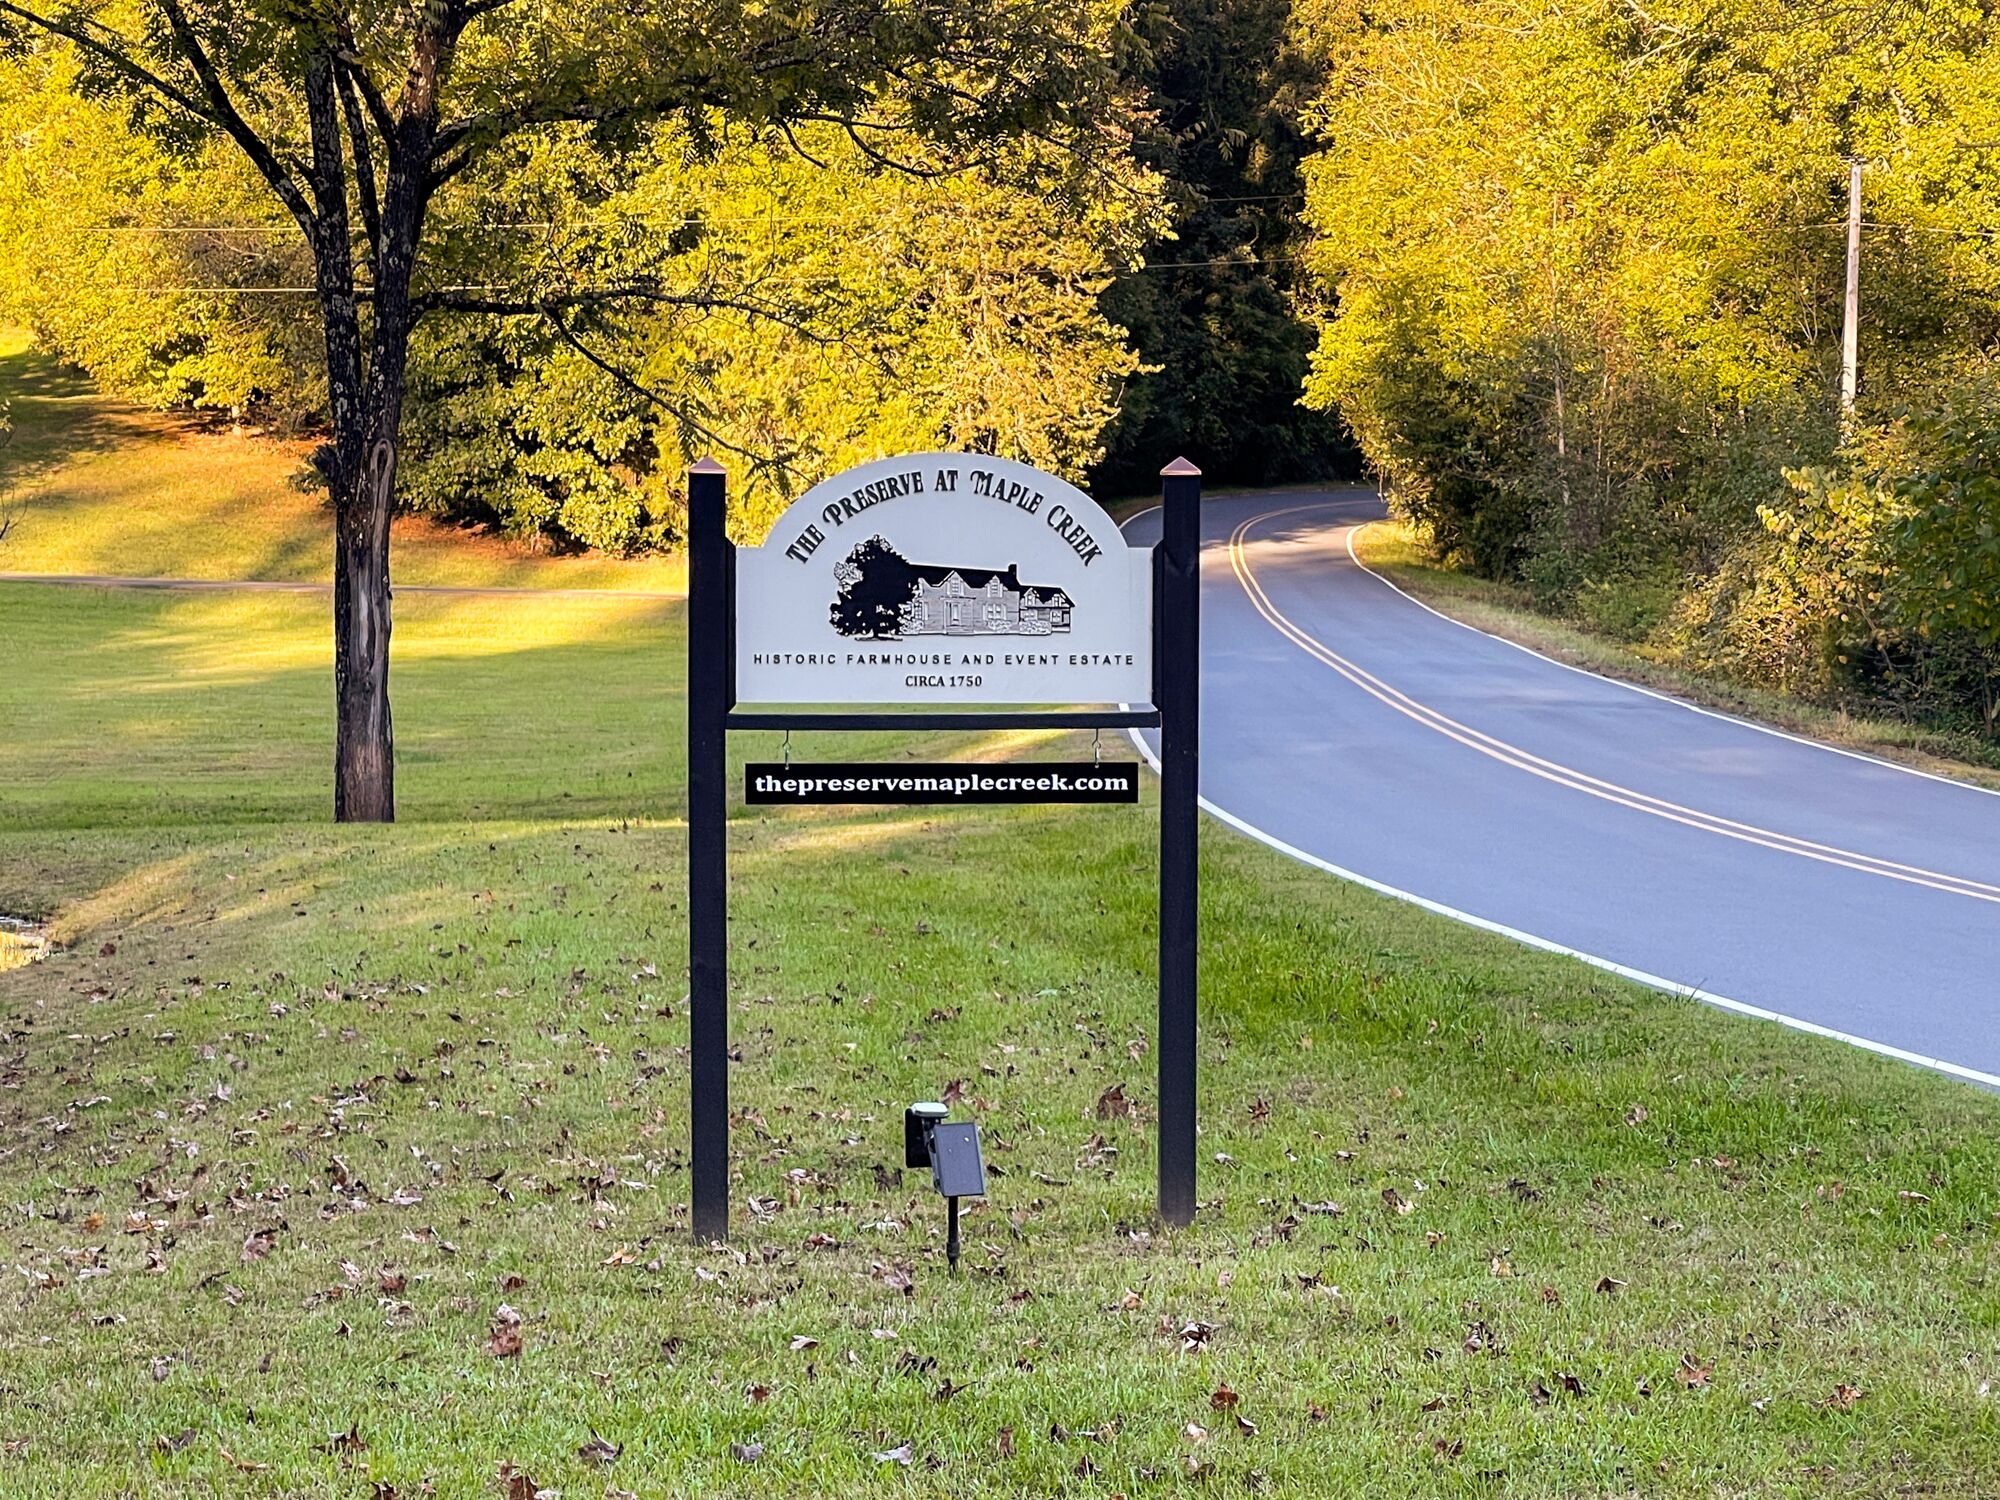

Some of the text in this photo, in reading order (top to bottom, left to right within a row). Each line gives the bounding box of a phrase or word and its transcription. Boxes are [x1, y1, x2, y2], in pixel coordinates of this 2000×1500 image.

[784, 469, 1103, 566] THE PRESERVE AT MAPLE CREEK
[753, 654, 1133, 666] HISTORIC FARMHOUSE AND EVENT ESTATE
[905, 675, 983, 688] CIRCA 1750
[755, 773, 1129, 796] thepreservemaplecreek.com
